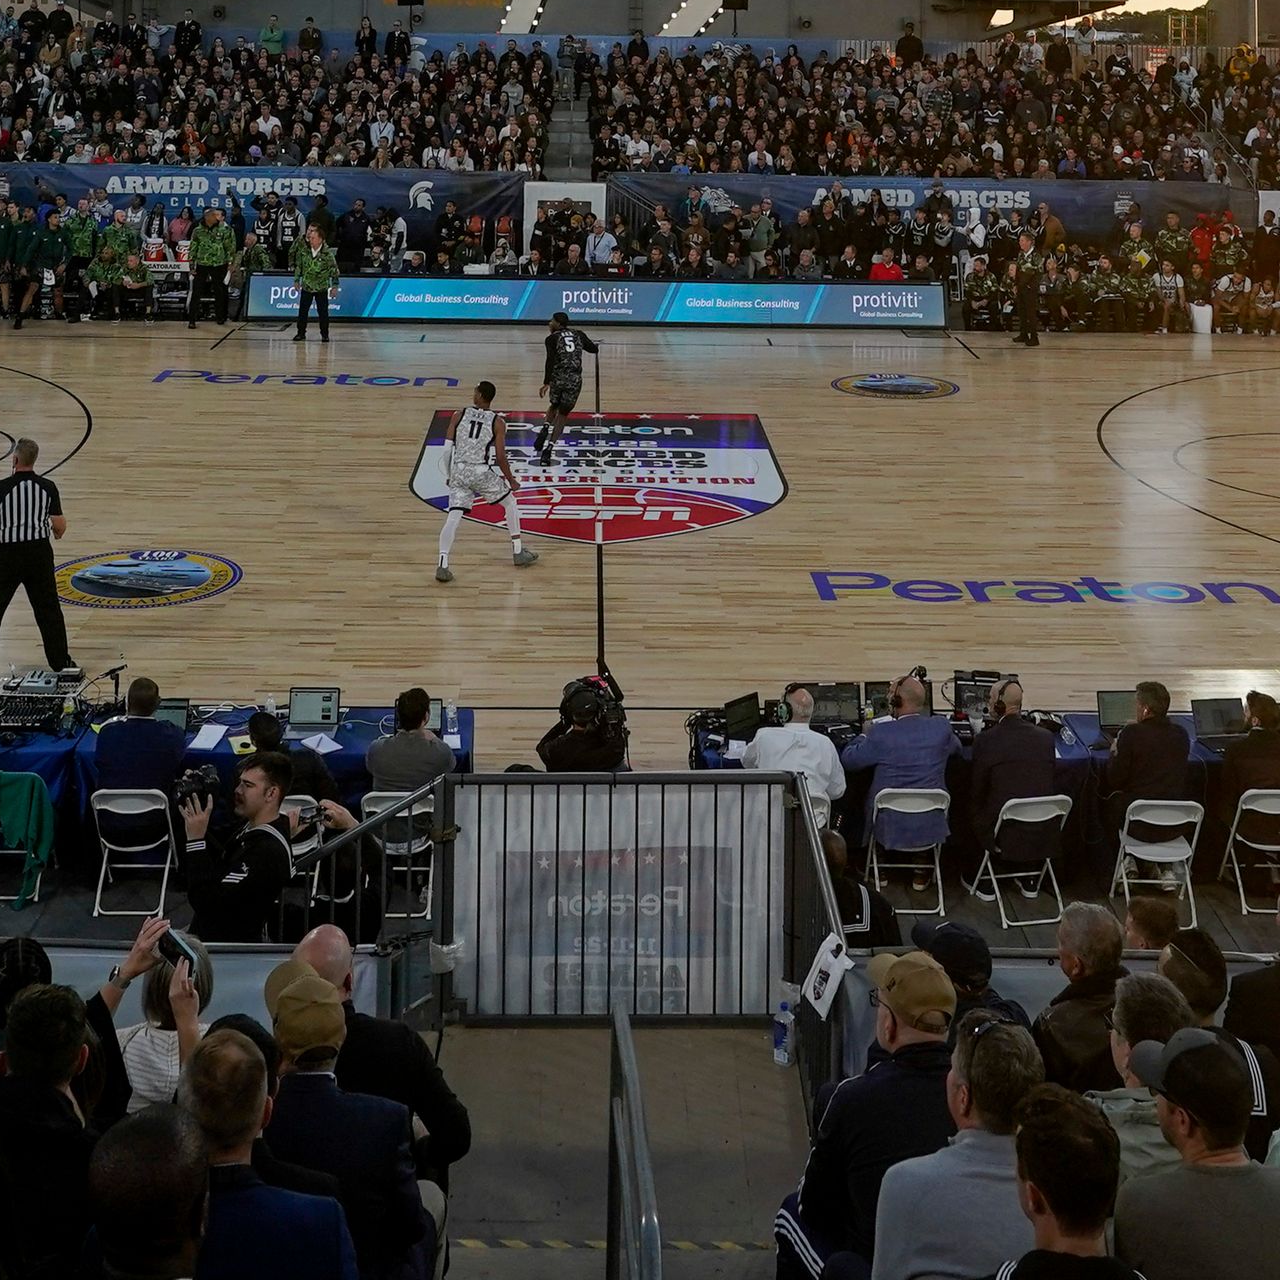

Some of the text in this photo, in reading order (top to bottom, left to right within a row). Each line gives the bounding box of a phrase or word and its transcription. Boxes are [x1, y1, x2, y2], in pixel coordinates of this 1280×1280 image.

[106, 175, 327, 197] ARMED FORCES
[811, 187, 915, 207] AMED
[394, 293, 509, 306] Global Business Consulting
[562, 287, 629, 308] protiviti
[685, 298, 800, 310] Global Business Consulting
[852, 291, 918, 313] protiviti
[607, 307, 633, 315] Consulting
[564, 337, 576, 353] 5
[152, 368, 460, 388] Peraton
[468, 420, 484, 440] 11
[615, 476, 756, 485] EDITION
[516, 504, 692, 521] ESPN
[140, 550, 179, 559] 100
